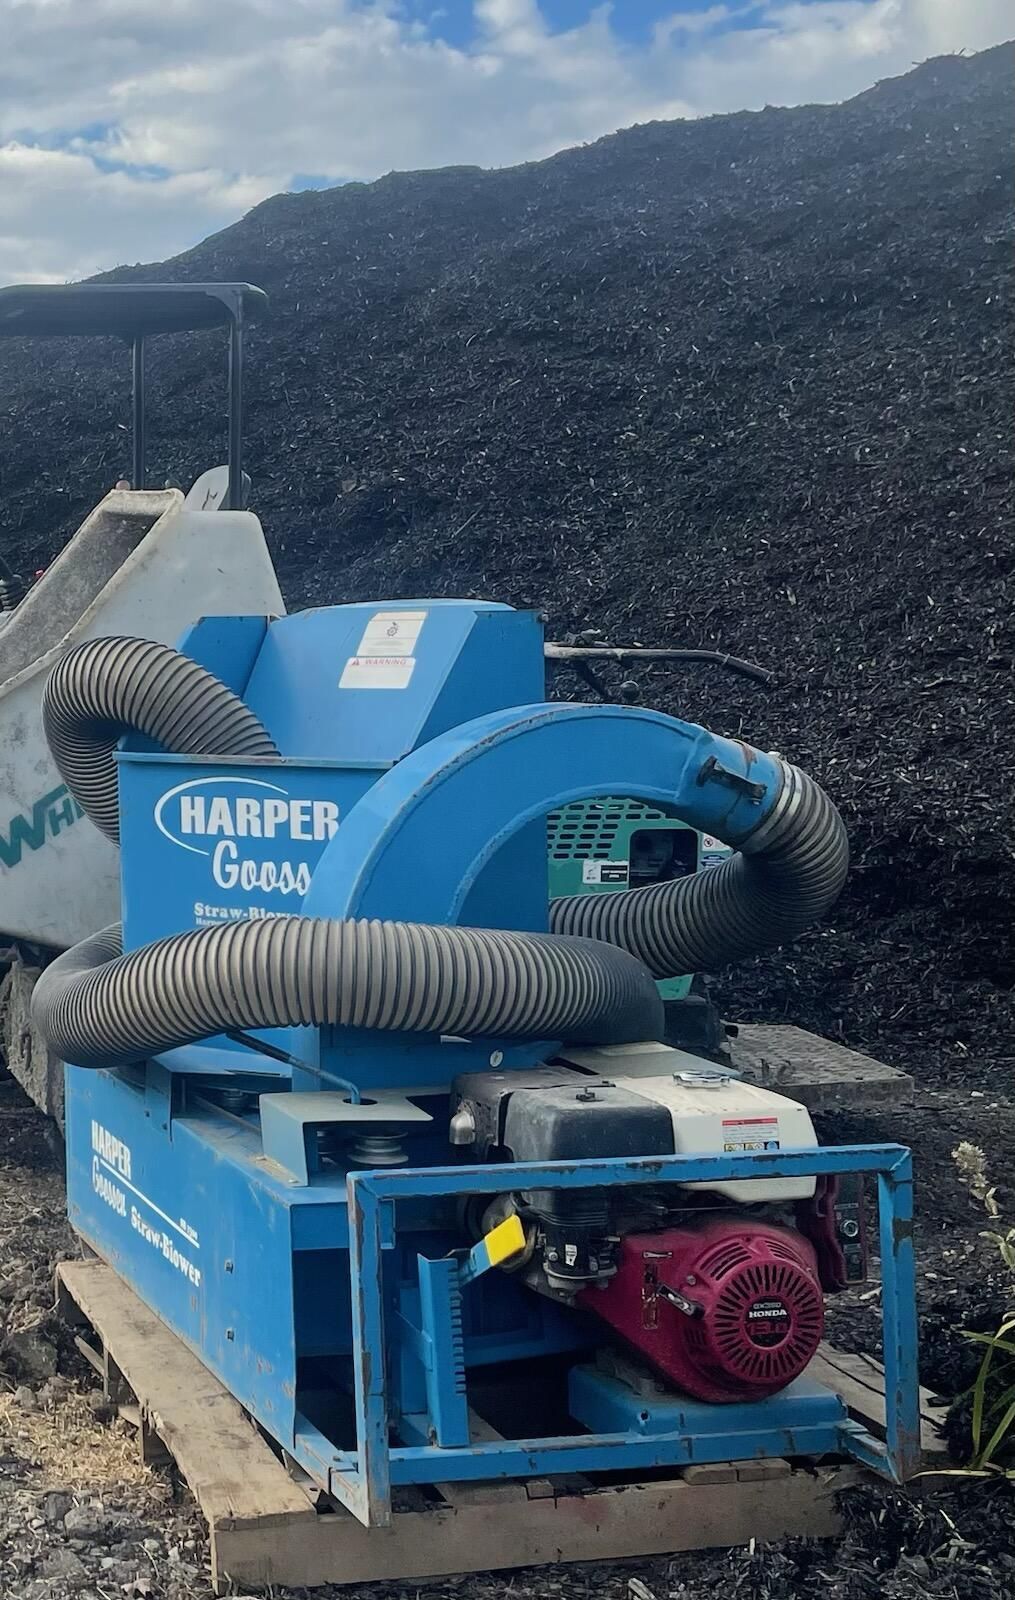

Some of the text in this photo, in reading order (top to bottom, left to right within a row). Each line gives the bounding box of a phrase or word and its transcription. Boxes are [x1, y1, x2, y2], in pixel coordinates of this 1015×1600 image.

[180, 796, 340, 841] HARPER
[91, 1119, 132, 1181] HARPER
[130, 1205, 201, 1288] Straw-Blower
[748, 1309, 788, 1318] HONDA
